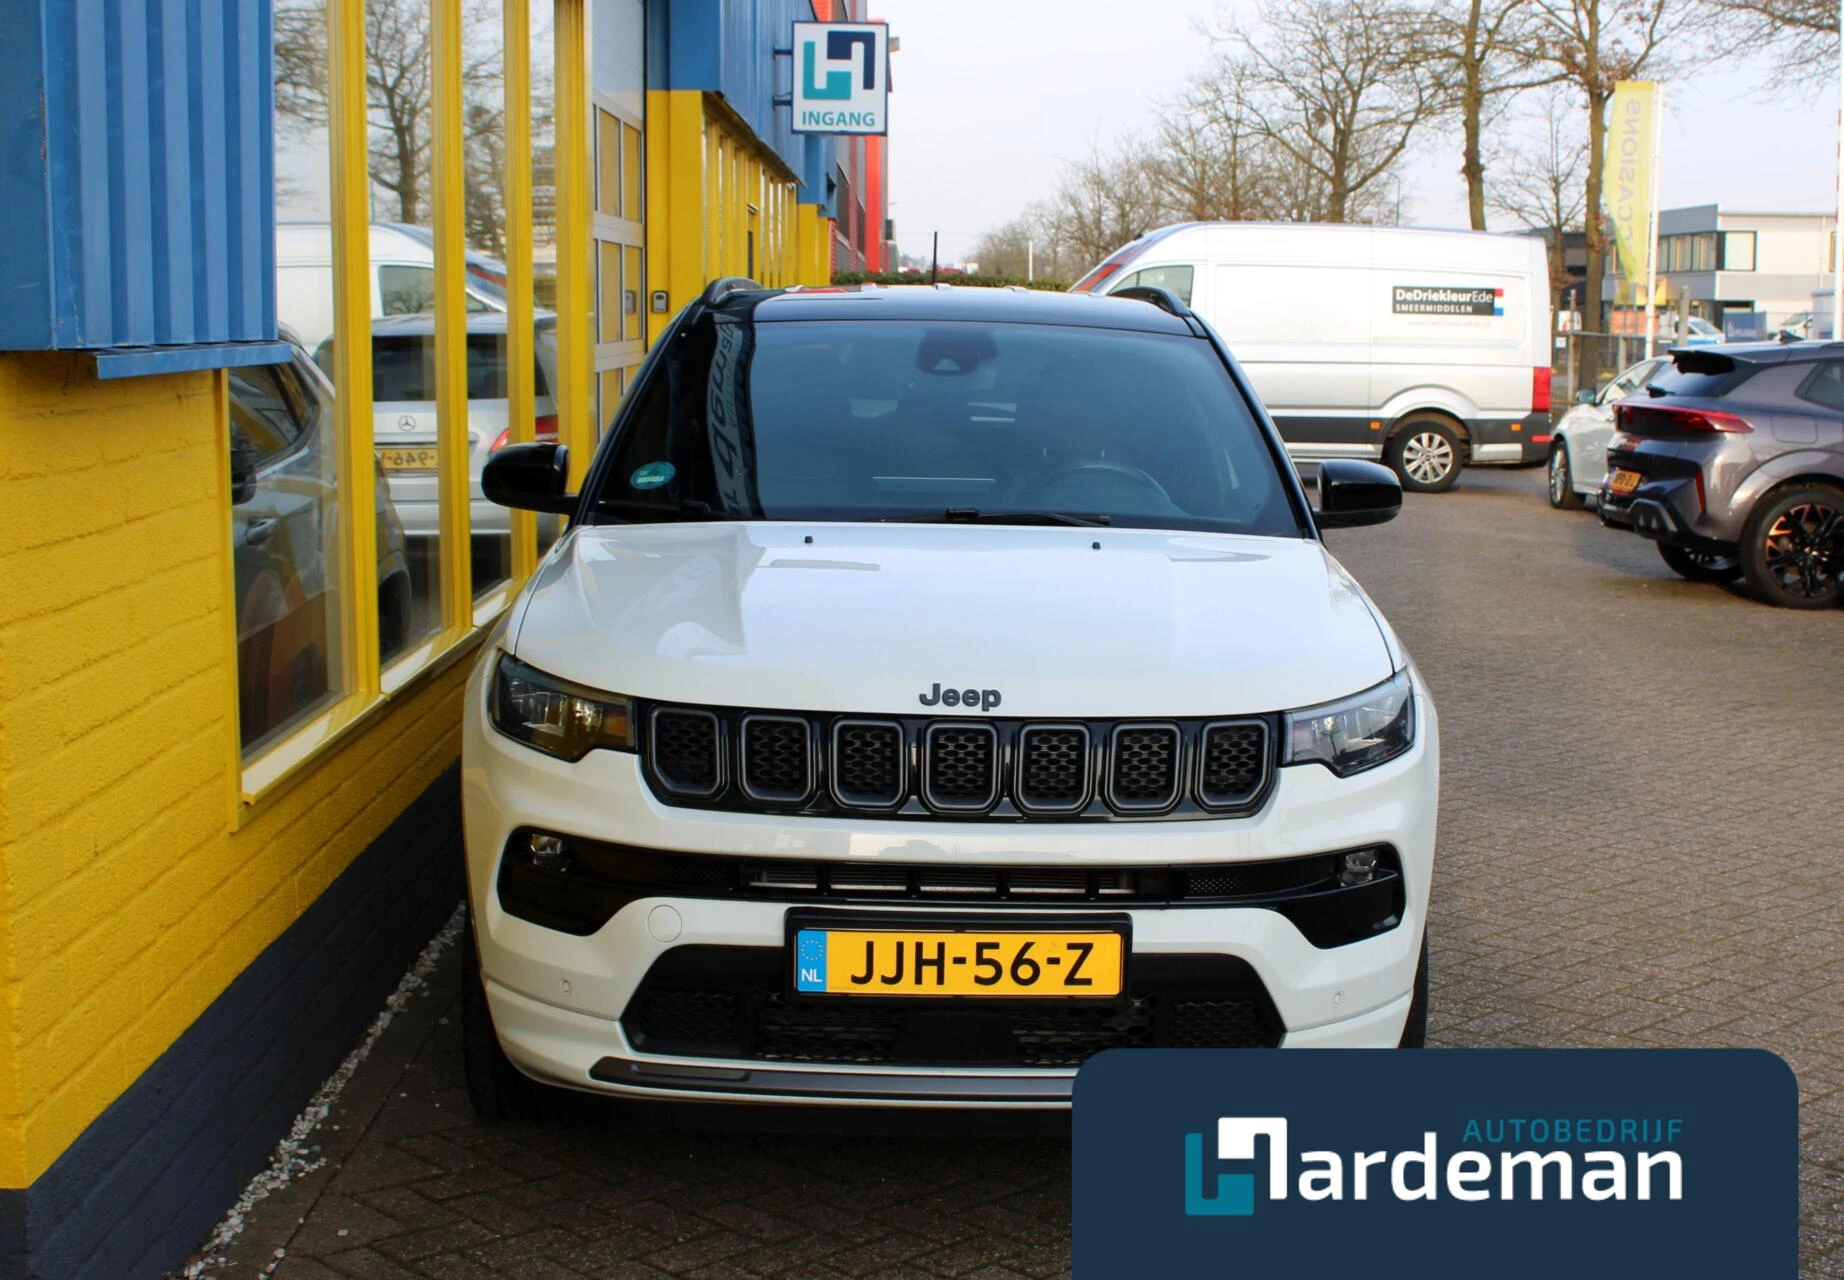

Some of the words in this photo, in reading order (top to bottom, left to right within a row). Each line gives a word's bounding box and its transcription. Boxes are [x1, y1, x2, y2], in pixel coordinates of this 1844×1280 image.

[802, 111, 875, 127] INGANG
[1395, 288, 1494, 304] DeDriekleurEde
[1395, 303, 1473, 313] SMEERMIDDELEN
[919, 683, 1002, 712] Jeep
[850, 940, 1095, 987] JJH-56-Z
[801, 969, 823, 983] NL
